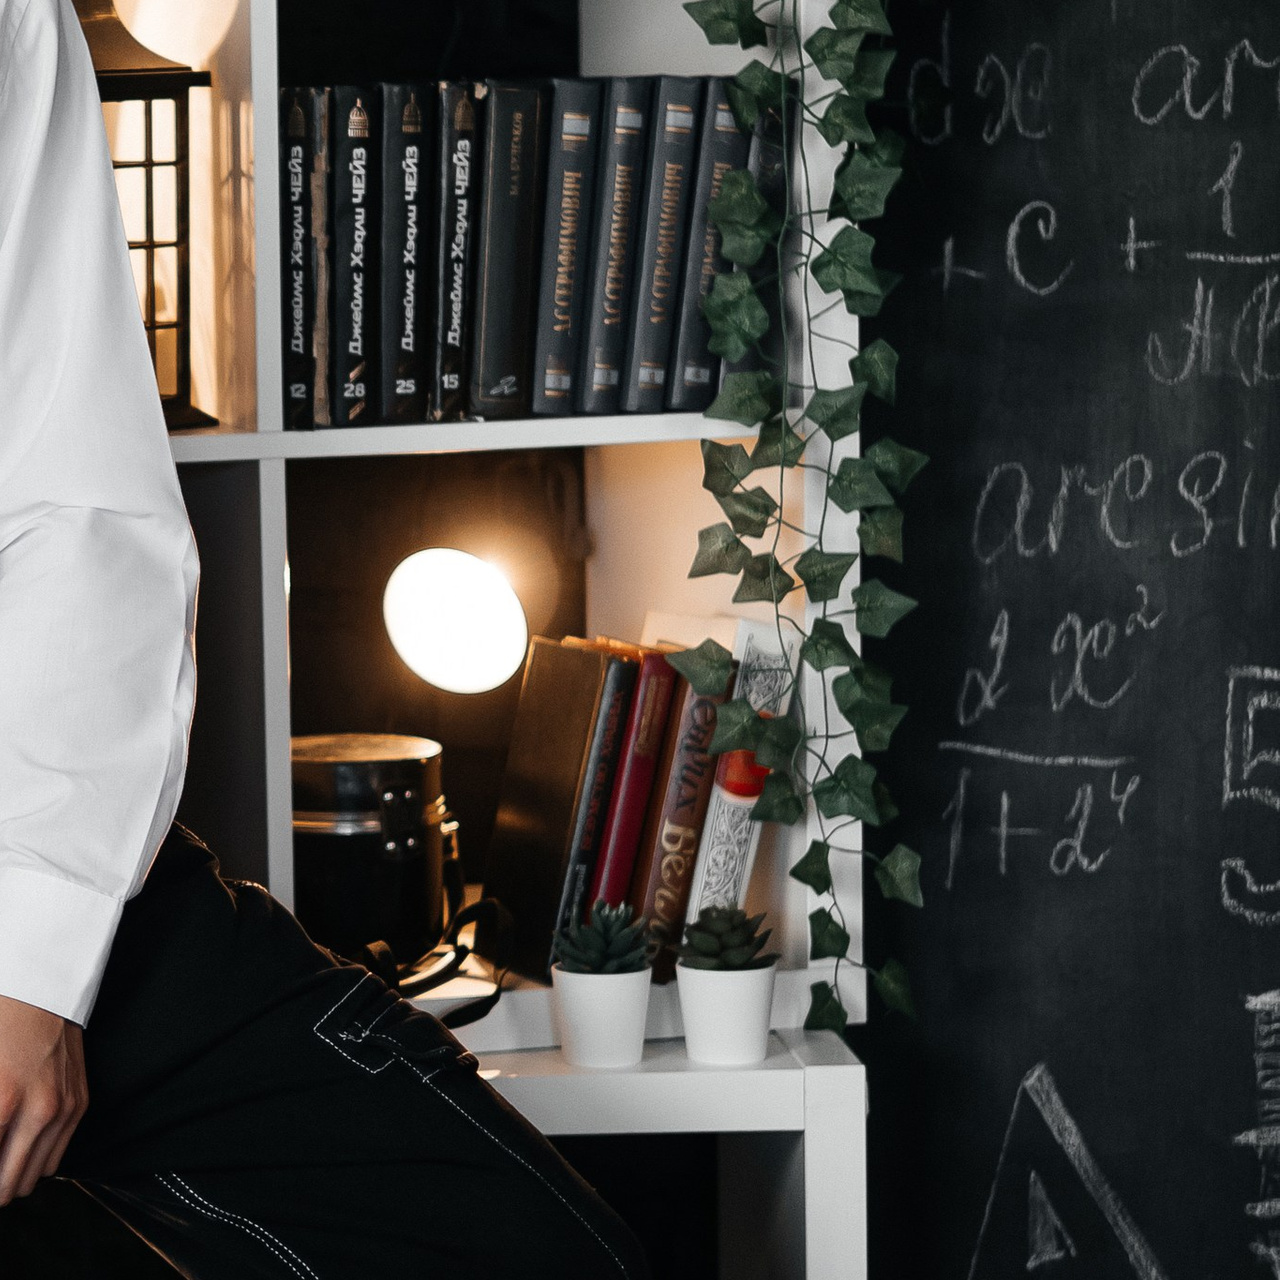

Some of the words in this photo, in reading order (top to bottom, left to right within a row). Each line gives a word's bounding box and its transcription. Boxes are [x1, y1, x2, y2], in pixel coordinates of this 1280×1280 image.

[288, 144, 302, 201] ЧЕЙЗ
[348, 147, 366, 203] ЧЕЙЗ
[401, 144, 418, 200] ЧЕЙЗ
[450, 138, 470, 195] ЧЕЙЗ
[291, 205, 303, 265] Хэдли
[350, 207, 366, 267] Хэдли
[403, 204, 417, 264] Хэдли
[450, 198, 469, 259] Хэдли
[290, 270, 304, 353] Джеймс
[348, 272, 363, 355] Джеймс
[401, 269, 415, 351] Джеймс
[445, 262, 465, 347] Джеймс
[290, 382, 306, 398] 12
[343, 382, 365, 397] 28
[395, 378, 415, 393] 25
[441, 373, 459, 389] 15
